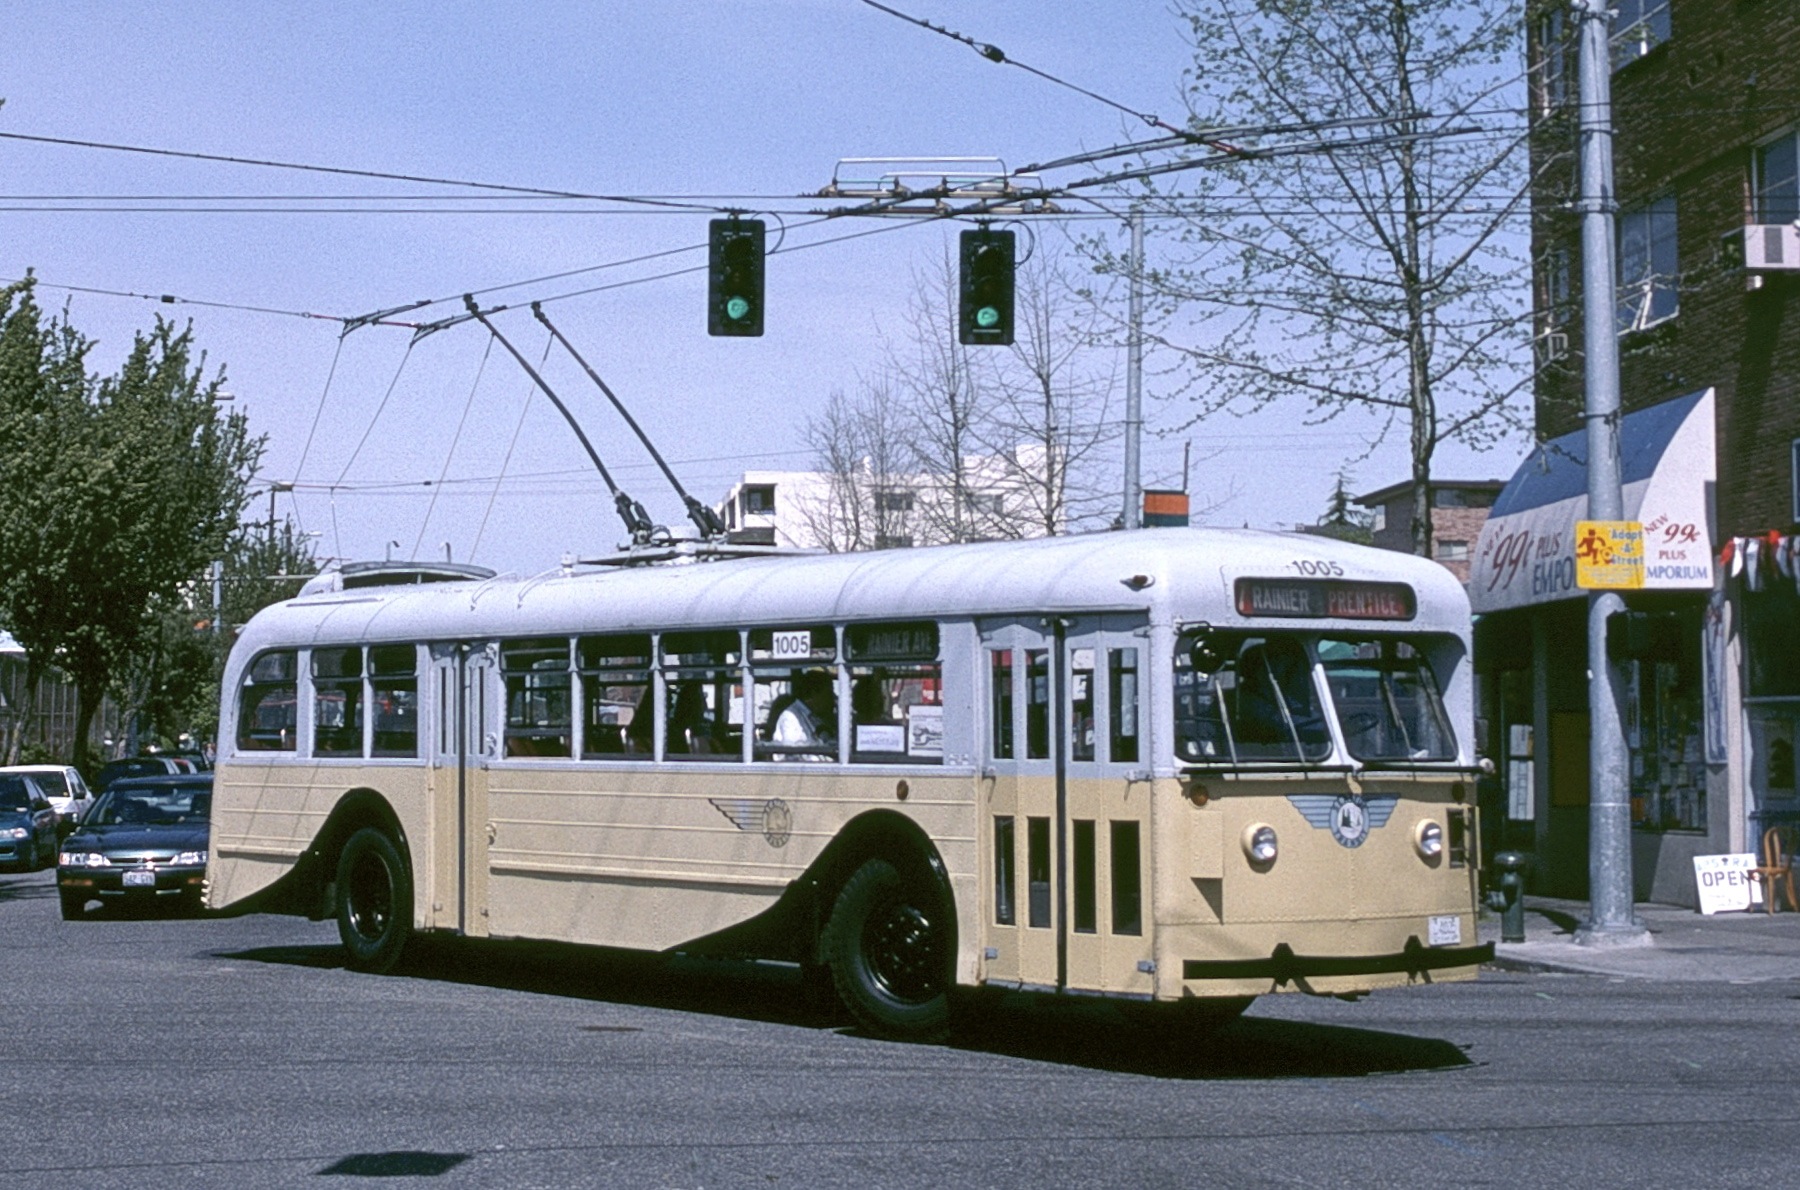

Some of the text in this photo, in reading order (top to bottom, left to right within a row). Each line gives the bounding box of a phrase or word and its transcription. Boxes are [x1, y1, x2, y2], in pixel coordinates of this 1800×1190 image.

[1644, 513, 1669, 535] NEW
[1611, 529, 1643, 541] Adopt
[1658, 550, 1687, 560] PLUS
[1293, 560, 1344, 577] 1005
[1533, 556, 1576, 595] EMPO
[1646, 565, 1708, 579] MPORIUM
[1252, 587, 1310, 612] RAINIER
[1328, 590, 1399, 615] PRENTICE
[774, 635, 809, 654] 1005
[1702, 870, 1750, 887] OPEN
